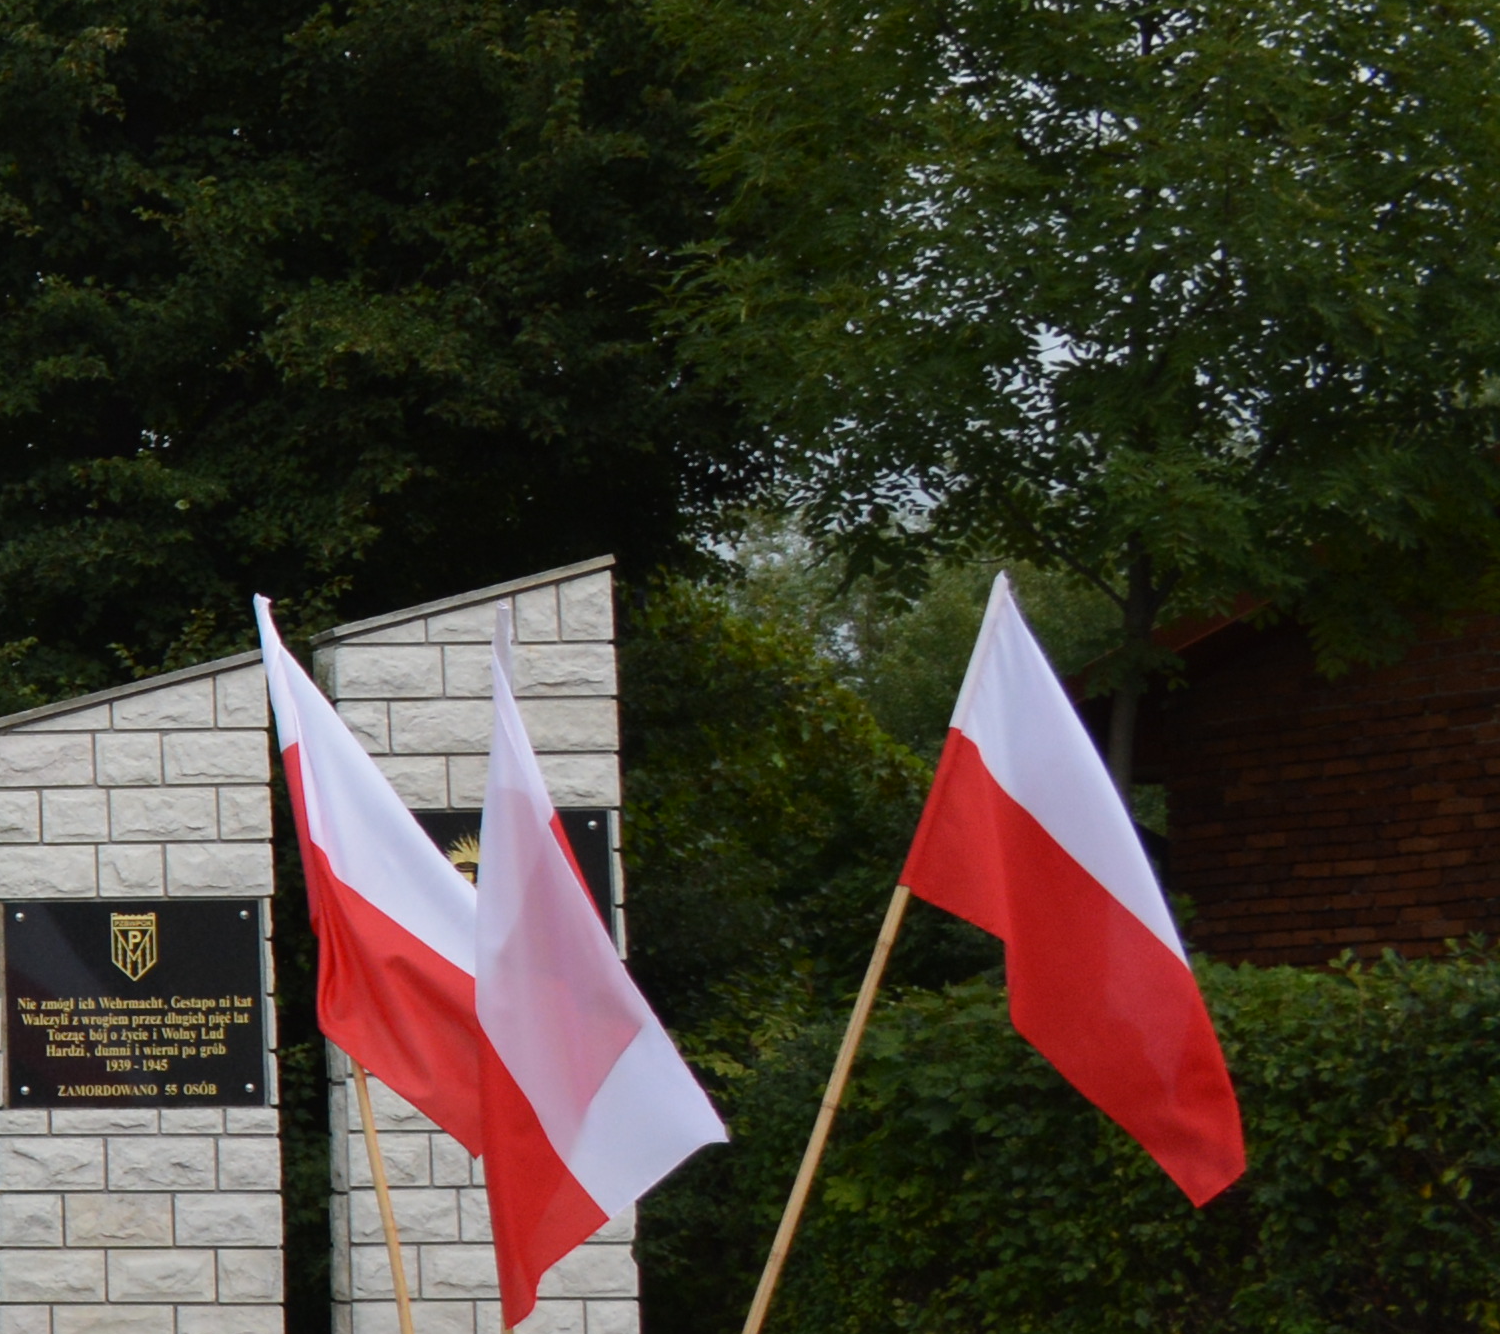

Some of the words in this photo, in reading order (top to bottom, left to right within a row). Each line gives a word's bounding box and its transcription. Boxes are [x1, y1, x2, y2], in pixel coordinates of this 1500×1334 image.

[17, 997, 37, 1010] Nie
[41, 997, 74, 1012] zmógł
[78, 997, 95, 1009] ich
[171, 995, 216, 1011] Gestapo
[218, 995, 230, 1007] ni
[234, 995, 253, 1007] kat
[21, 1013, 69, 1028] Walczyli
[72, 1016, 79, 1025] z
[81, 1013, 129, 1028] wrogiem
[131, 1015, 162, 1028] przez
[164, 1012, 206, 1026] długich
[208, 1011, 232, 1027] pięć
[233, 1011, 249, 1023] lat
[46, 1028, 86, 1044] Tocząc
[89, 1028, 108, 1044] bój
[110, 1032, 118, 1041] o
[120, 1028, 149, 1043] życie
[152, 1027, 158, 1040] i
[161, 1027, 197, 1043] Wolny
[201, 1027, 224, 1040] Lud
[94, 1044, 131, 1057] dumni
[135, 1043, 140, 1056] i
[143, 1043, 179, 1056] wierni
[181, 1046, 196, 1058] po
[200, 1043, 227, 1058] grób
[105, 1059, 132, 1072] 1939
[142, 1059, 168, 1072] 1945
[57, 1084, 158, 1097] ZAMORDOWANO
[164, 1083, 178, 1096] 55
[183, 1080, 218, 1096] OSÓB
